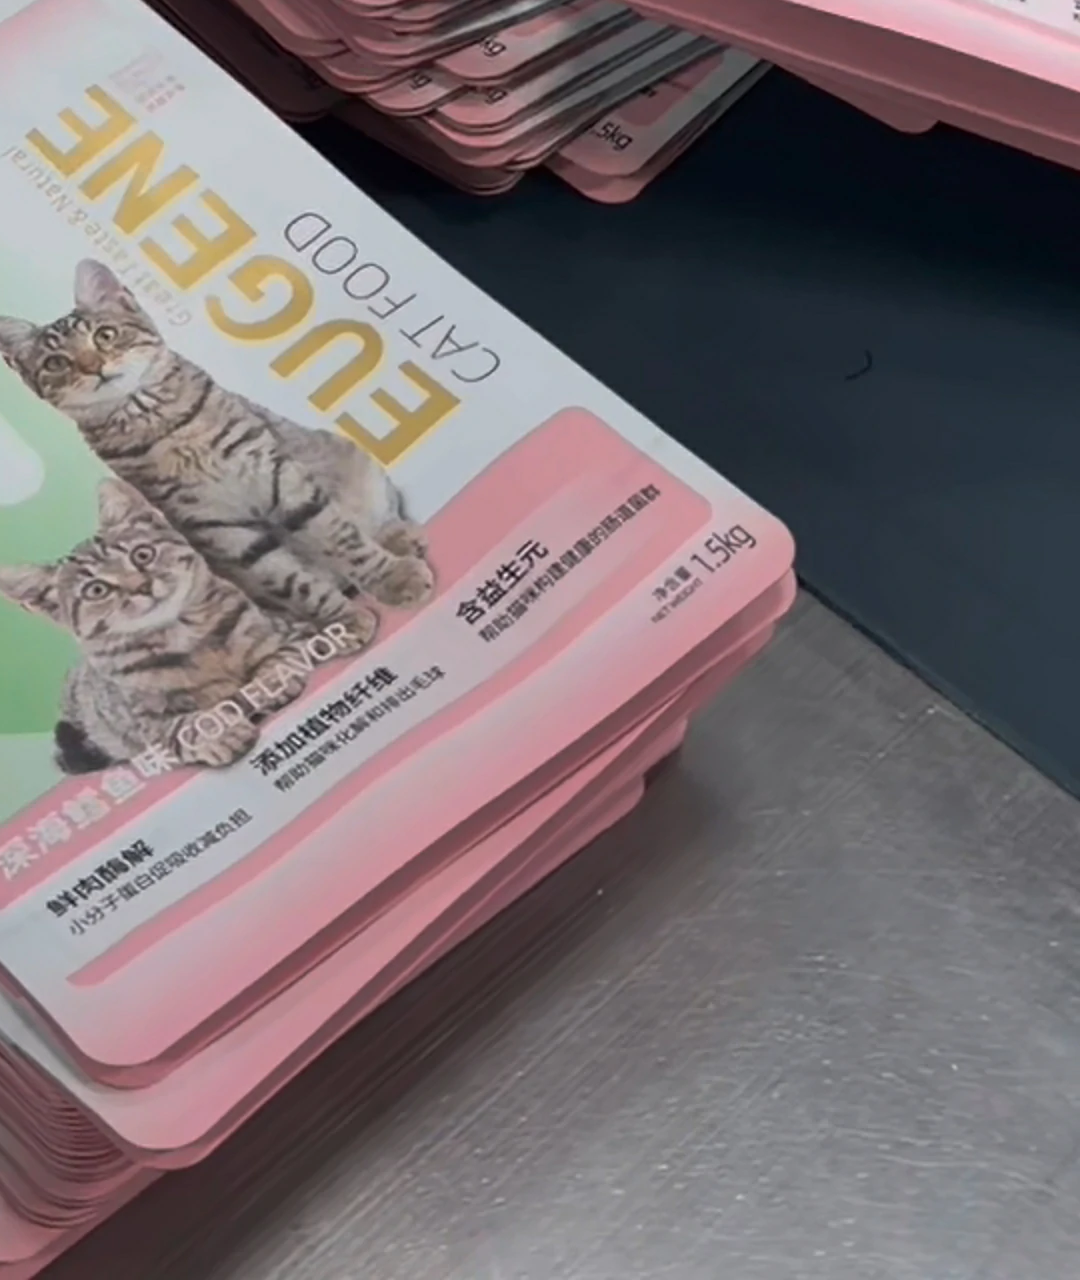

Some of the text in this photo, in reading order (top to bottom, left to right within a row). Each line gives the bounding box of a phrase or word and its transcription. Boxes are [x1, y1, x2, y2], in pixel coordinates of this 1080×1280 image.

[25, 83, 462, 468] EUGENE
[283, 211, 502, 384] CAT FOOD
[456, 538, 550, 626] 含益生元
[689, 523, 758, 575] 1.5kg
[175, 698, 245, 749] COD
[240, 622, 357, 711] FLAVOR
[251, 666, 399, 777] 添加植物纤维
[46, 839, 156, 917] 鲜肉酶解
